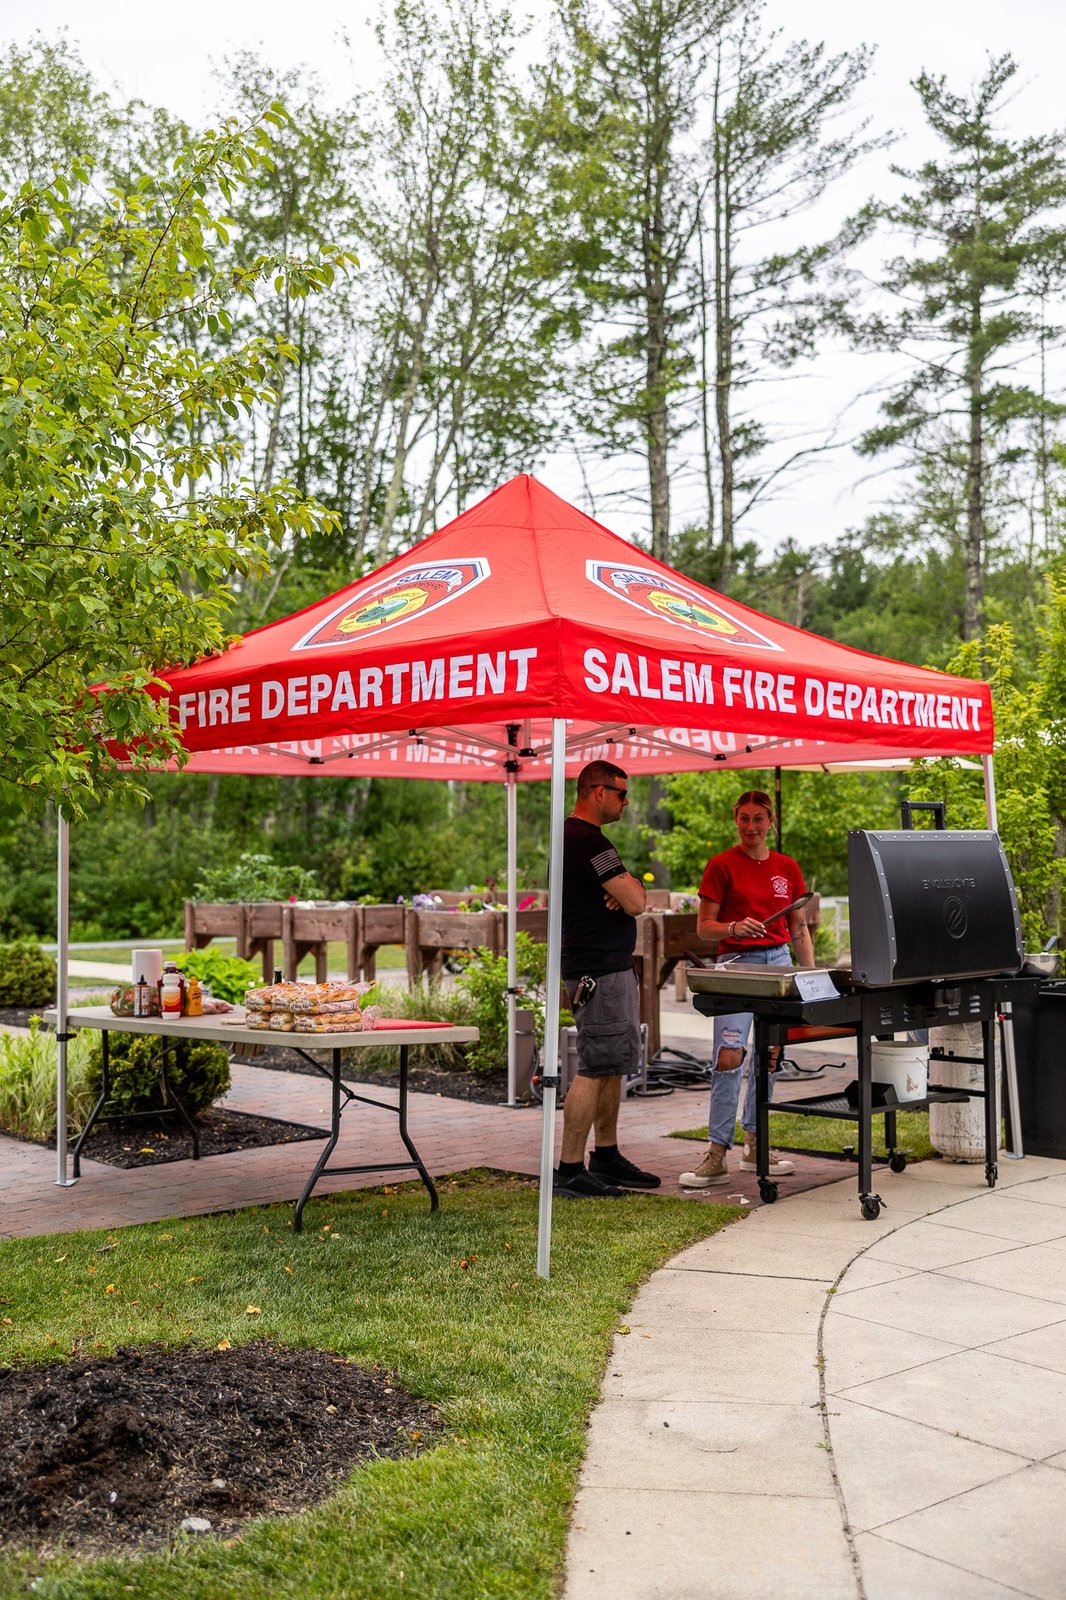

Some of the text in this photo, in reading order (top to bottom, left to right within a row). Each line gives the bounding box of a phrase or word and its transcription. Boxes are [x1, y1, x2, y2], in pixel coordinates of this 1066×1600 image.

[397, 570, 458, 585] SALEM
[613, 574, 669, 589] SALEM
[180, 685, 250, 730] FIRE
[262, 648, 537, 719] DEPARTMENT
[584, 649, 982, 731] SALEM FIRE DEPARTMENT
